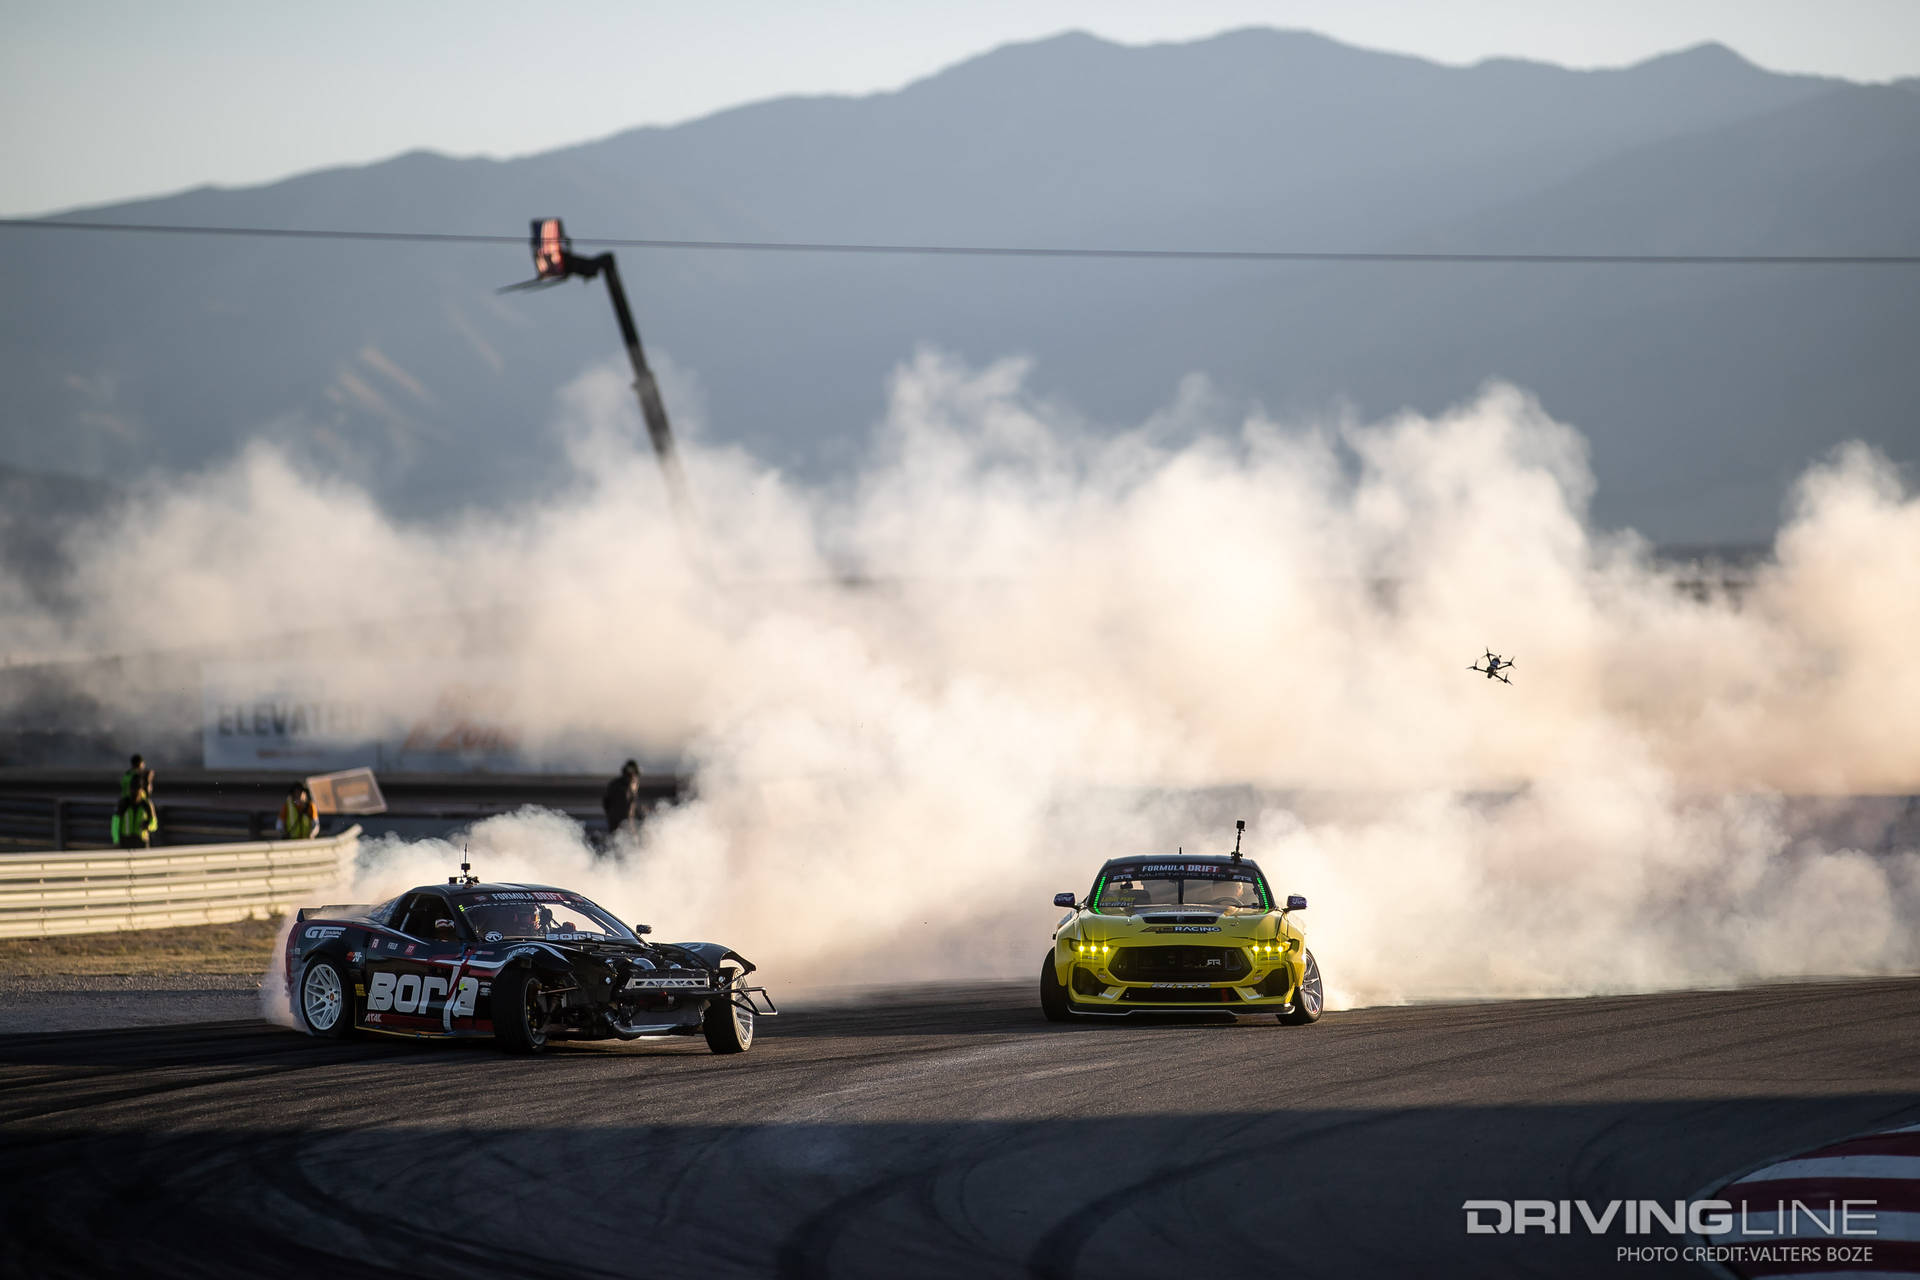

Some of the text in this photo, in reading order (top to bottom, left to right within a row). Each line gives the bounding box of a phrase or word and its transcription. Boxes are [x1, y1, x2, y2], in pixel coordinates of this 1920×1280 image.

[218, 703, 366, 736] ELEVATE
[1142, 864, 1219, 873] FORMULA DRIFT
[491, 892, 534, 901] FORMULA
[533, 892, 565, 901] DRIFT
